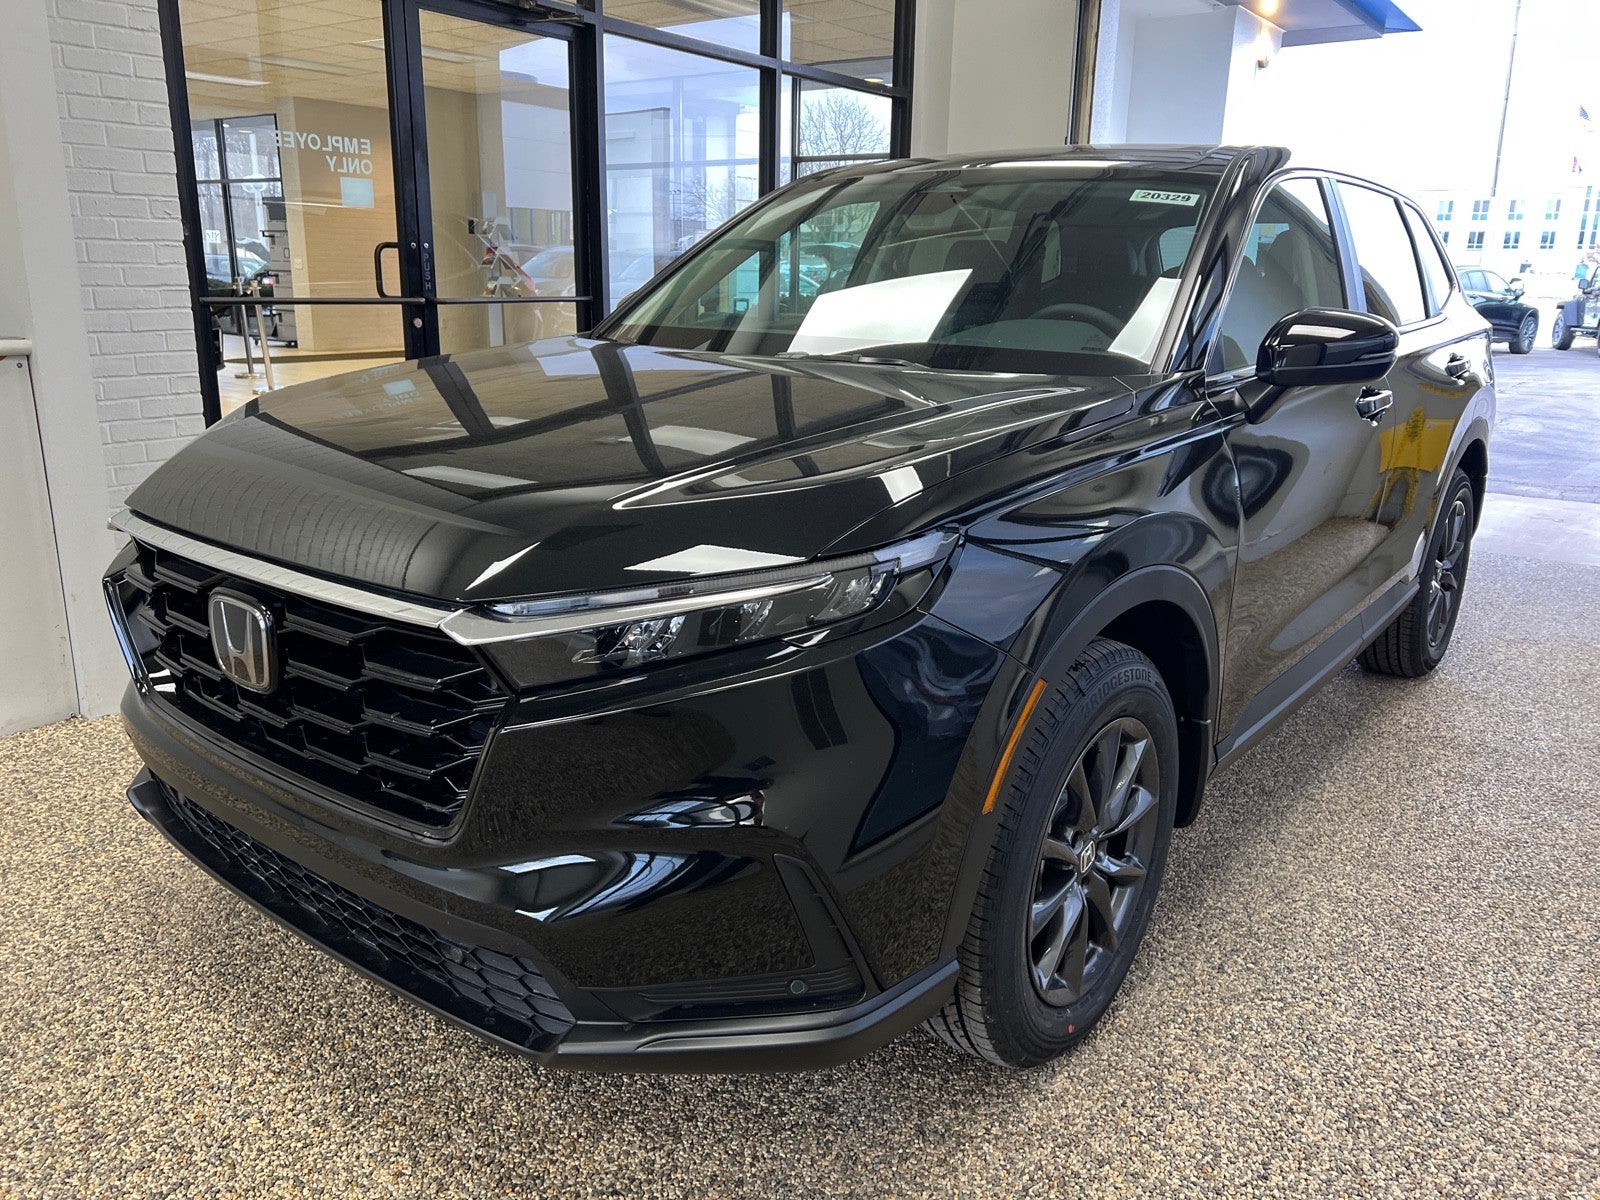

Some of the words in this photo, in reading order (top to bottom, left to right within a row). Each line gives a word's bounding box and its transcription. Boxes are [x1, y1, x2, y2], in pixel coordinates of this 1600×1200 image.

[1140, 191, 1192, 203] 20329
[423, 252, 432, 291] PUSH
[1080, 668, 1152, 719] BRIDGESTONE
